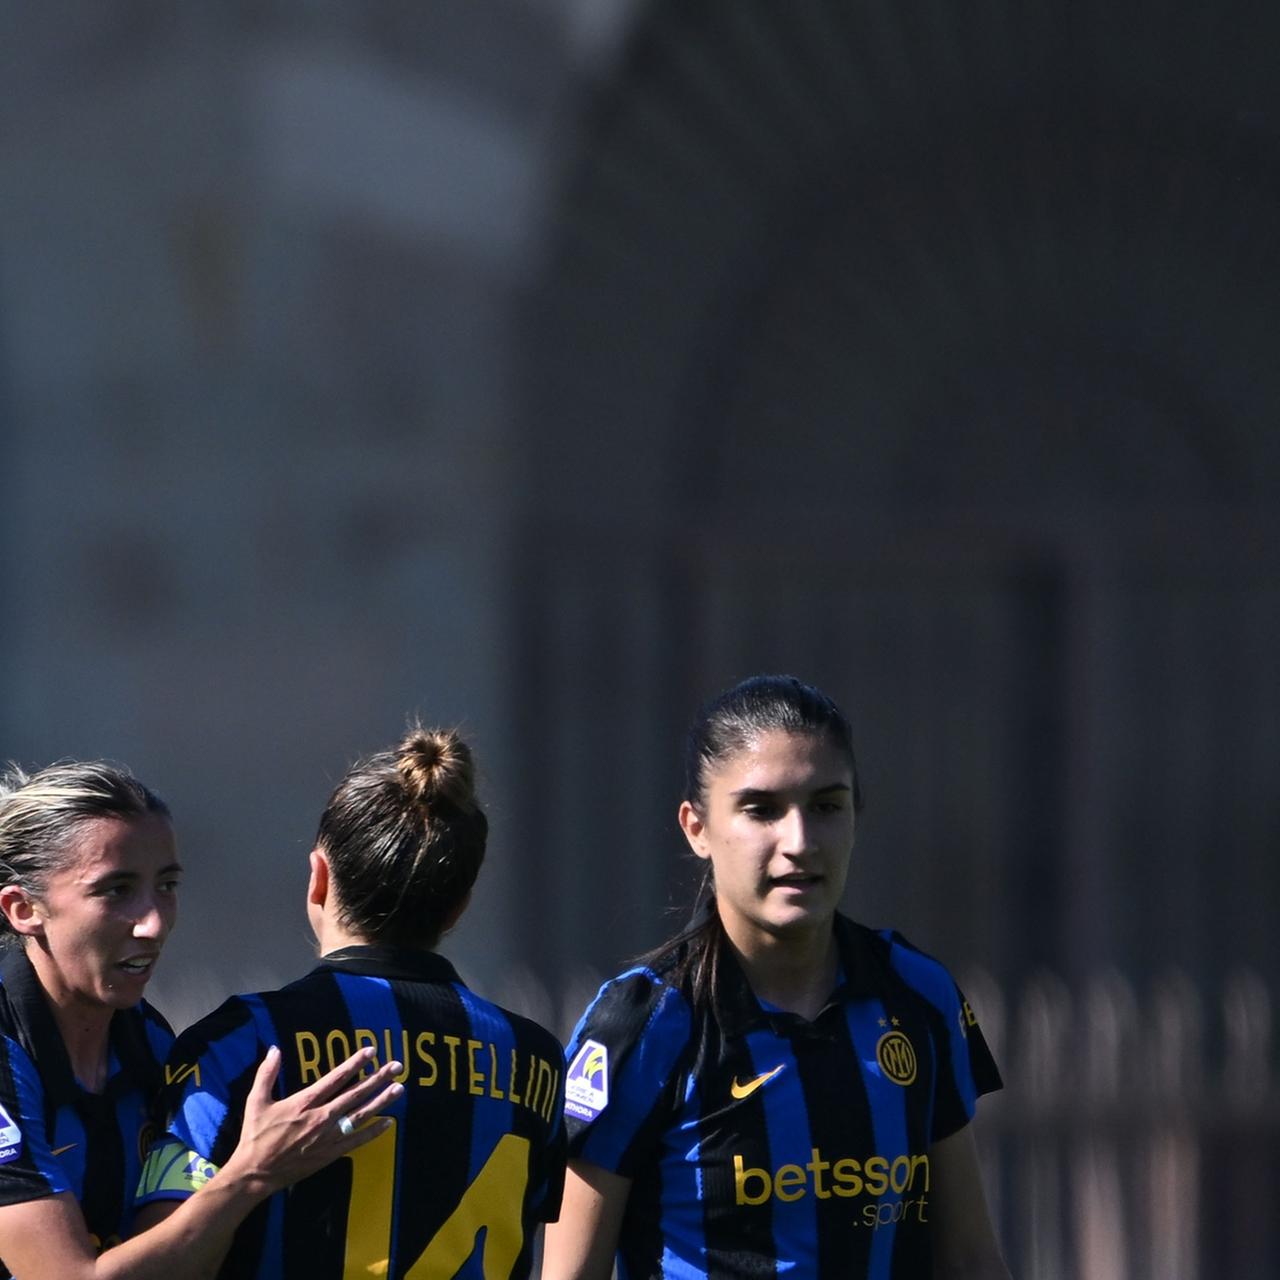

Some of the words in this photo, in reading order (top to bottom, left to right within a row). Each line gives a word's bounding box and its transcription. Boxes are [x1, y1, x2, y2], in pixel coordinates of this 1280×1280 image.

[164, 1063, 202, 1088] VA
[295, 1028, 559, 1124] ROBUSTELLINI
[733, 1147, 930, 1206] betsson
